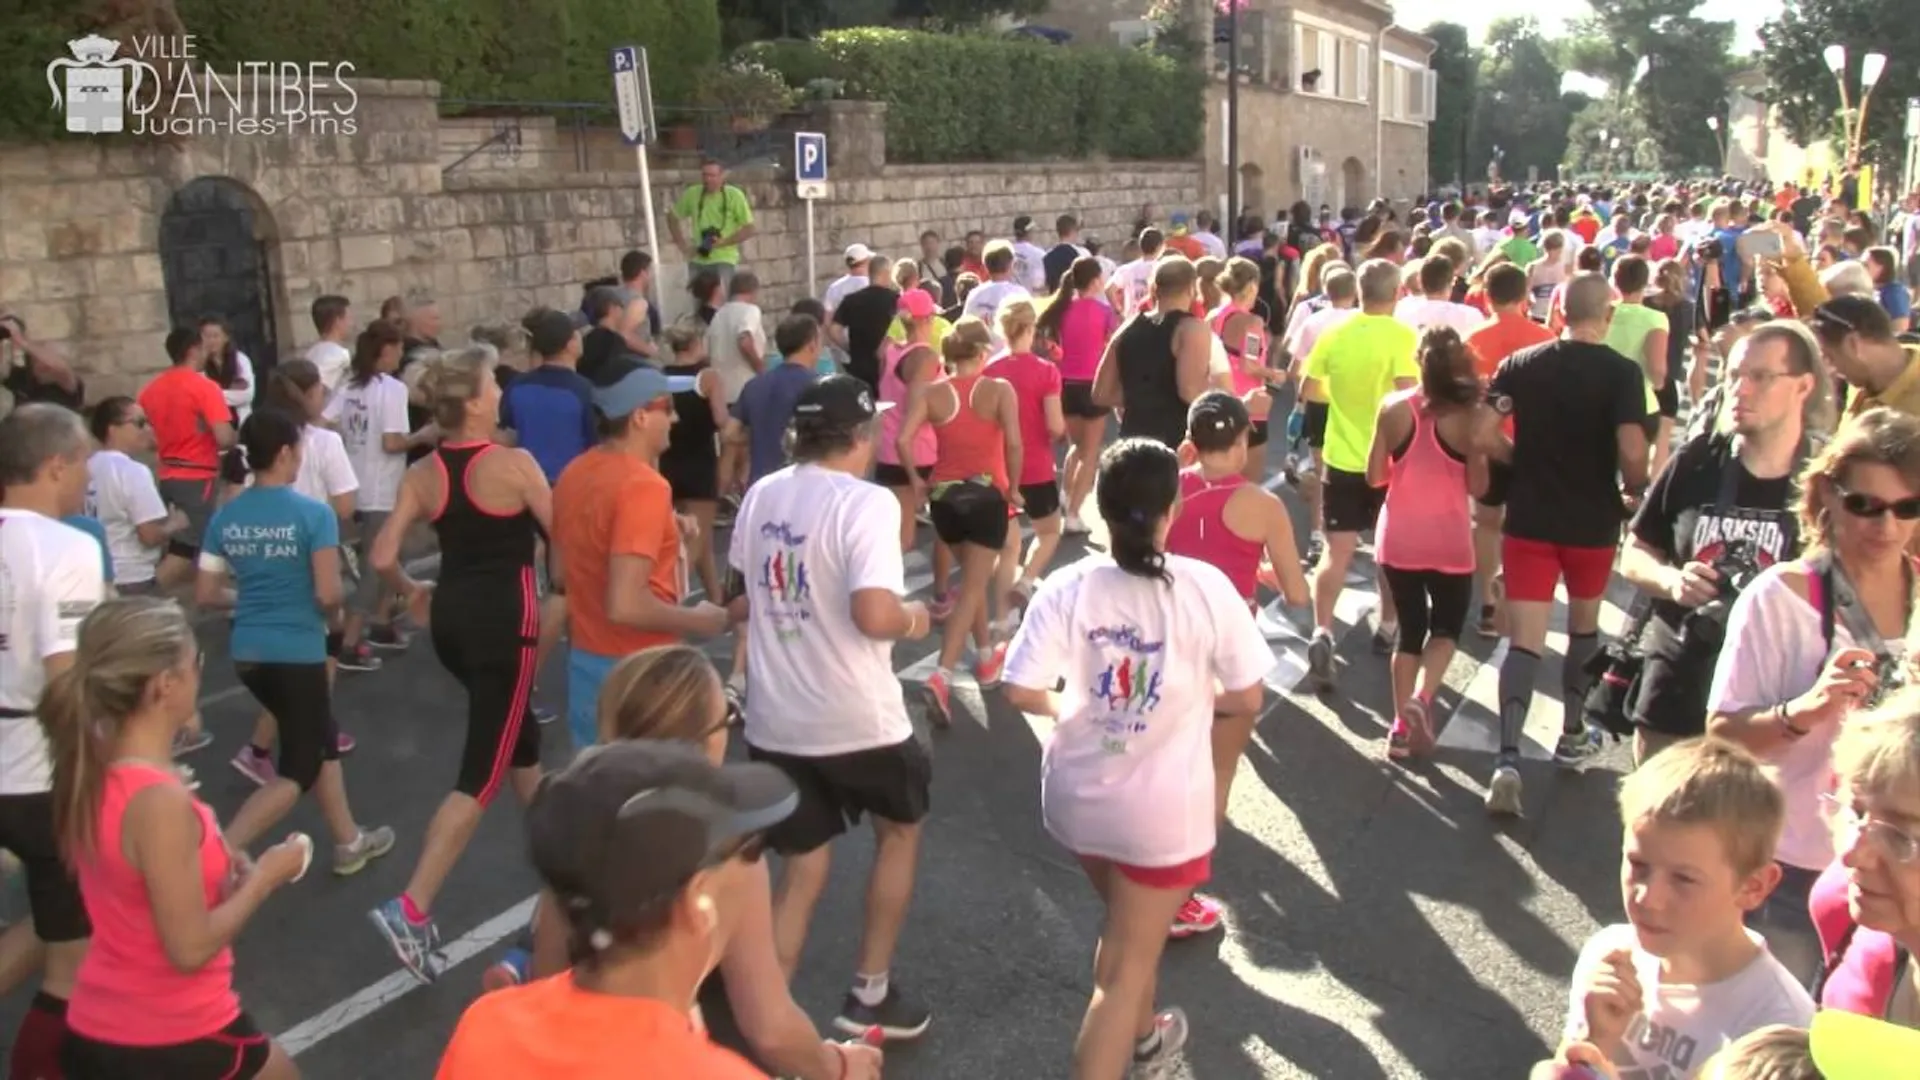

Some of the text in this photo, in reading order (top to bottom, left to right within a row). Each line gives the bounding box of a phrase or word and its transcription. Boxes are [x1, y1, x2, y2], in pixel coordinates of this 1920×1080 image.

[803, 143, 818, 173] P
[222, 522, 296, 541] PÔLE SANTÉ
[1624, 1014, 1697, 1072] rena
